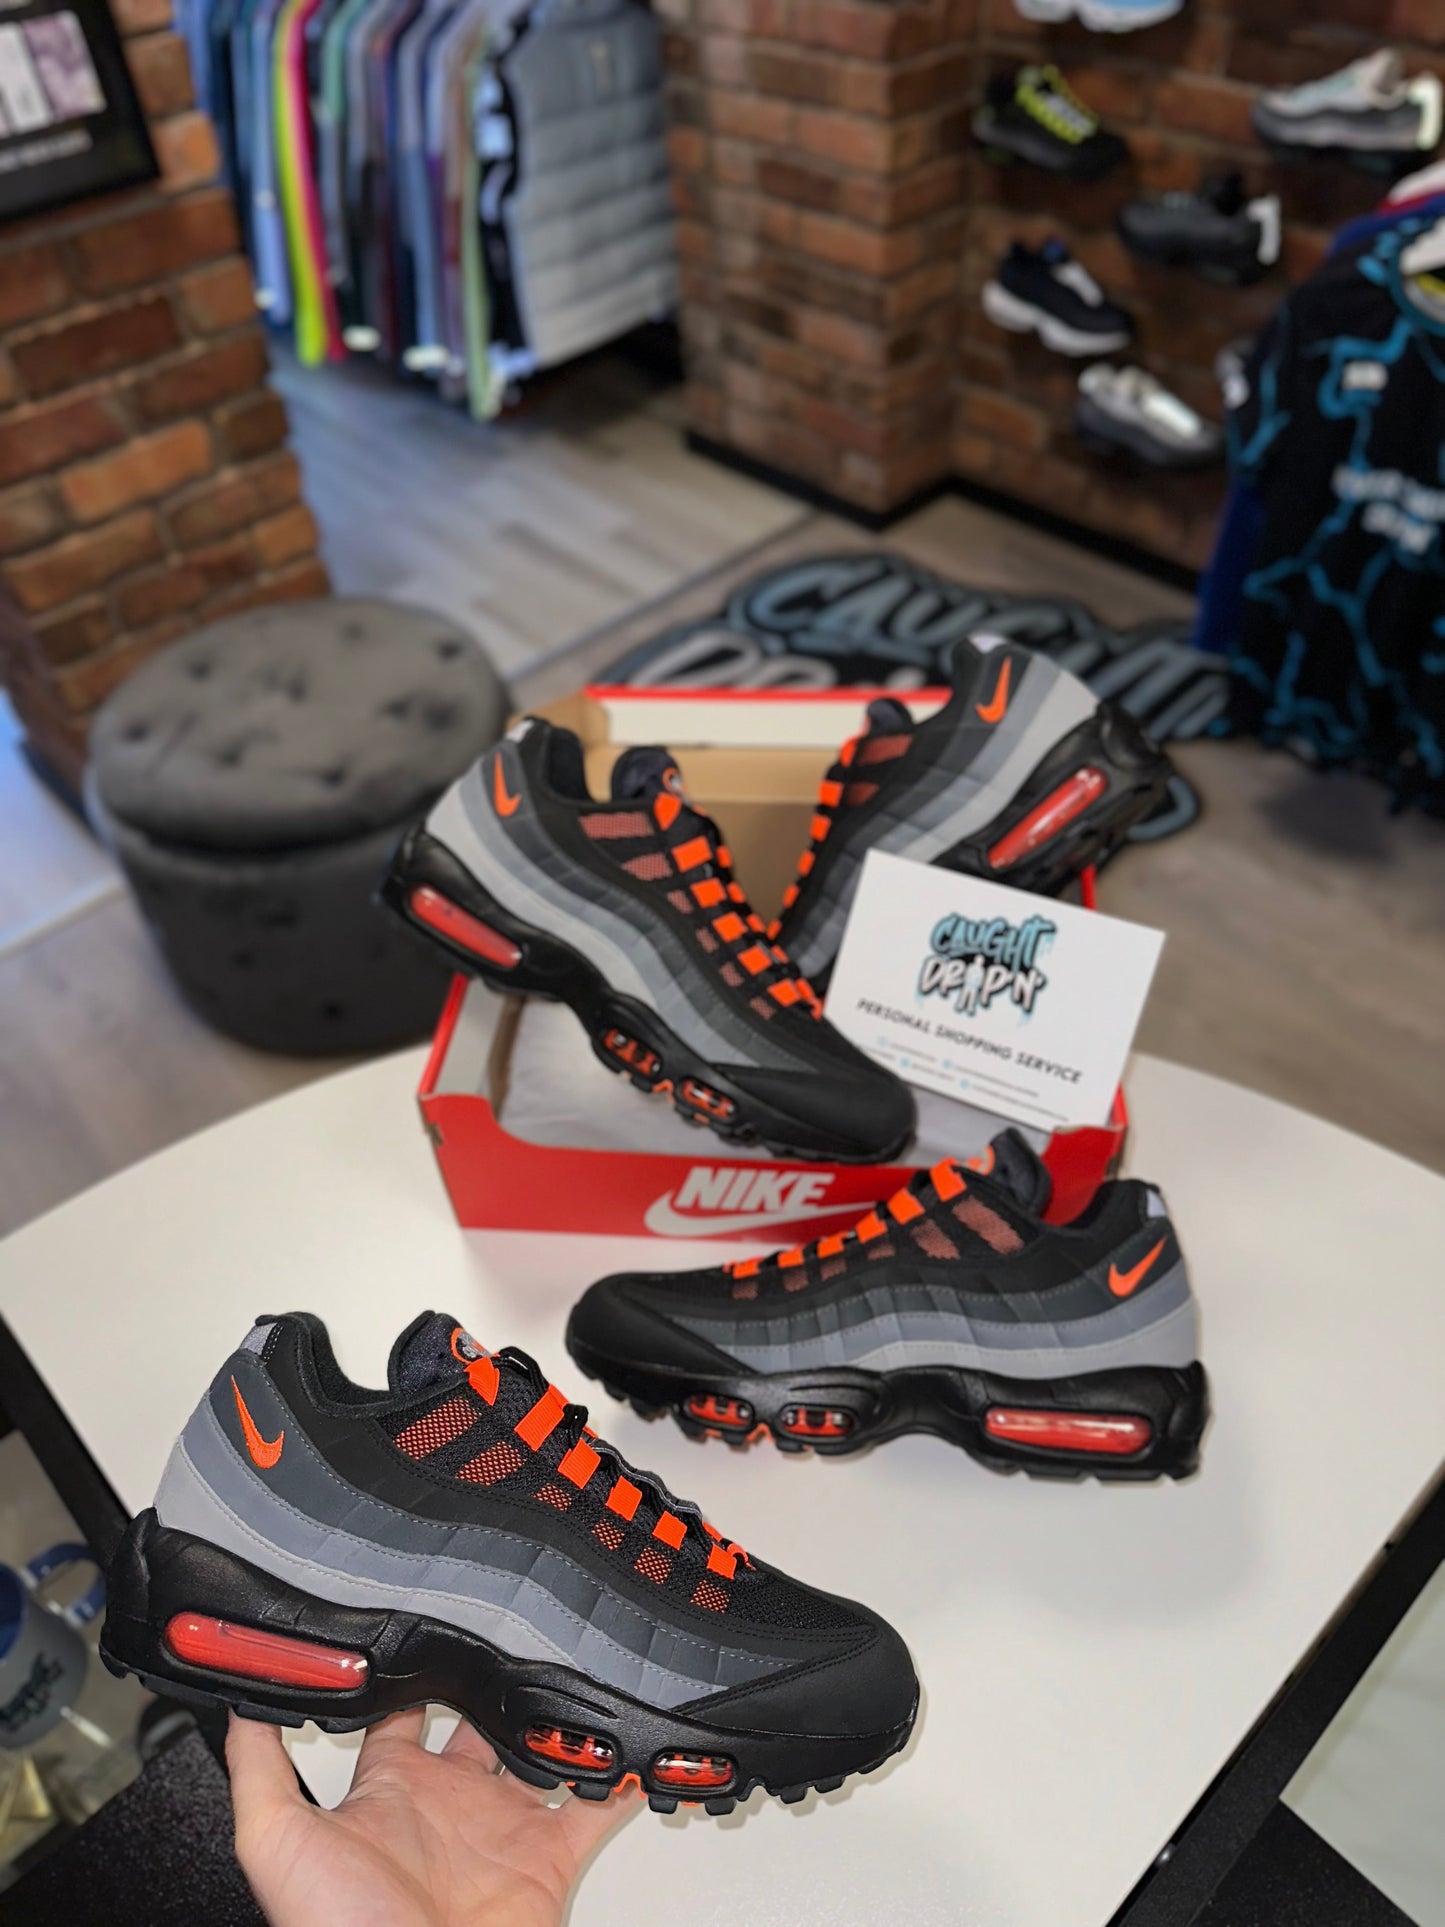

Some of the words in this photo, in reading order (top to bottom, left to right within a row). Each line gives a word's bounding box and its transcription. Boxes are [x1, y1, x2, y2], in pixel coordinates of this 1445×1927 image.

[931, 913, 1056, 972] CAUGHT
[857, 998, 931, 1034] PERSONAL
[935, 1024, 1012, 1060] SHOPPING
[1016, 1051, 1082, 1083] SERVICE
[674, 1166, 835, 1212] NIKE
